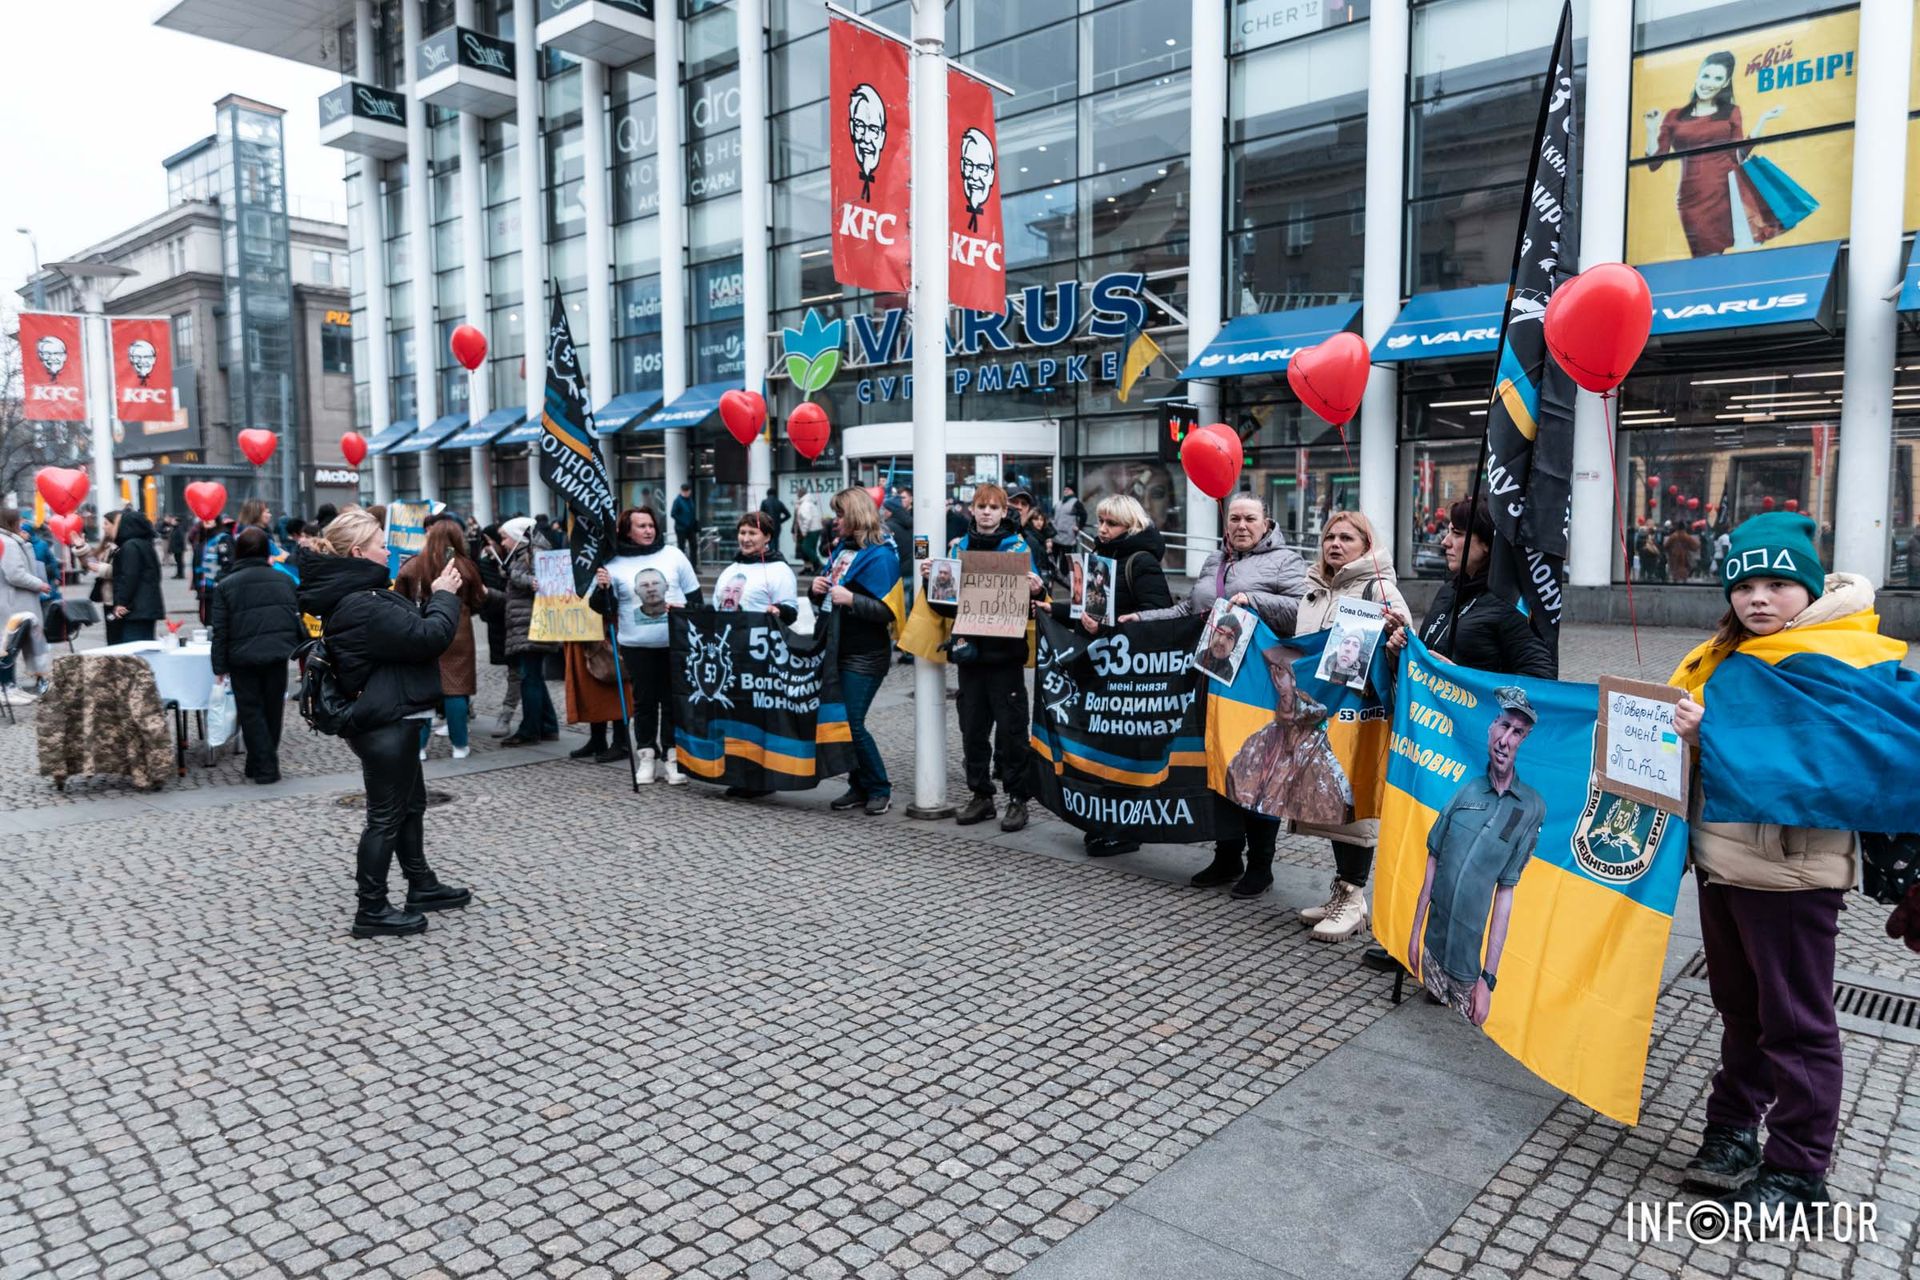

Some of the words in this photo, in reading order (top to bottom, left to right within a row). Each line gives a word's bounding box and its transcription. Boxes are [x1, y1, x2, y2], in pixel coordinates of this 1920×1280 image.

[1241, 6, 1298, 34] CHER
[1744, 40, 1794, 77] твій
[1757, 50, 1854, 93] ВИБІР!
[839, 203, 896, 245] KFC
[951, 232, 1002, 271] KFC
[1662, 293, 1808, 319] VARUS
[32, 385, 79, 401] KFC
[123, 387, 166, 403] KFC
[963, 573, 1018, 588] ДРУГИЙ
[1339, 605, 1356, 615] Сова
[704, 663, 717, 683] 53
[1043, 670, 1065, 694] 53
[1135, 682, 1167, 692] князя
[1339, 708, 1356, 722] 53
[1062, 787, 1194, 825] ВОЛНОВАХА
[1614, 810, 1631, 829] 53
[1576, 836, 1645, 876] МЕХАНІЗОВАНА
